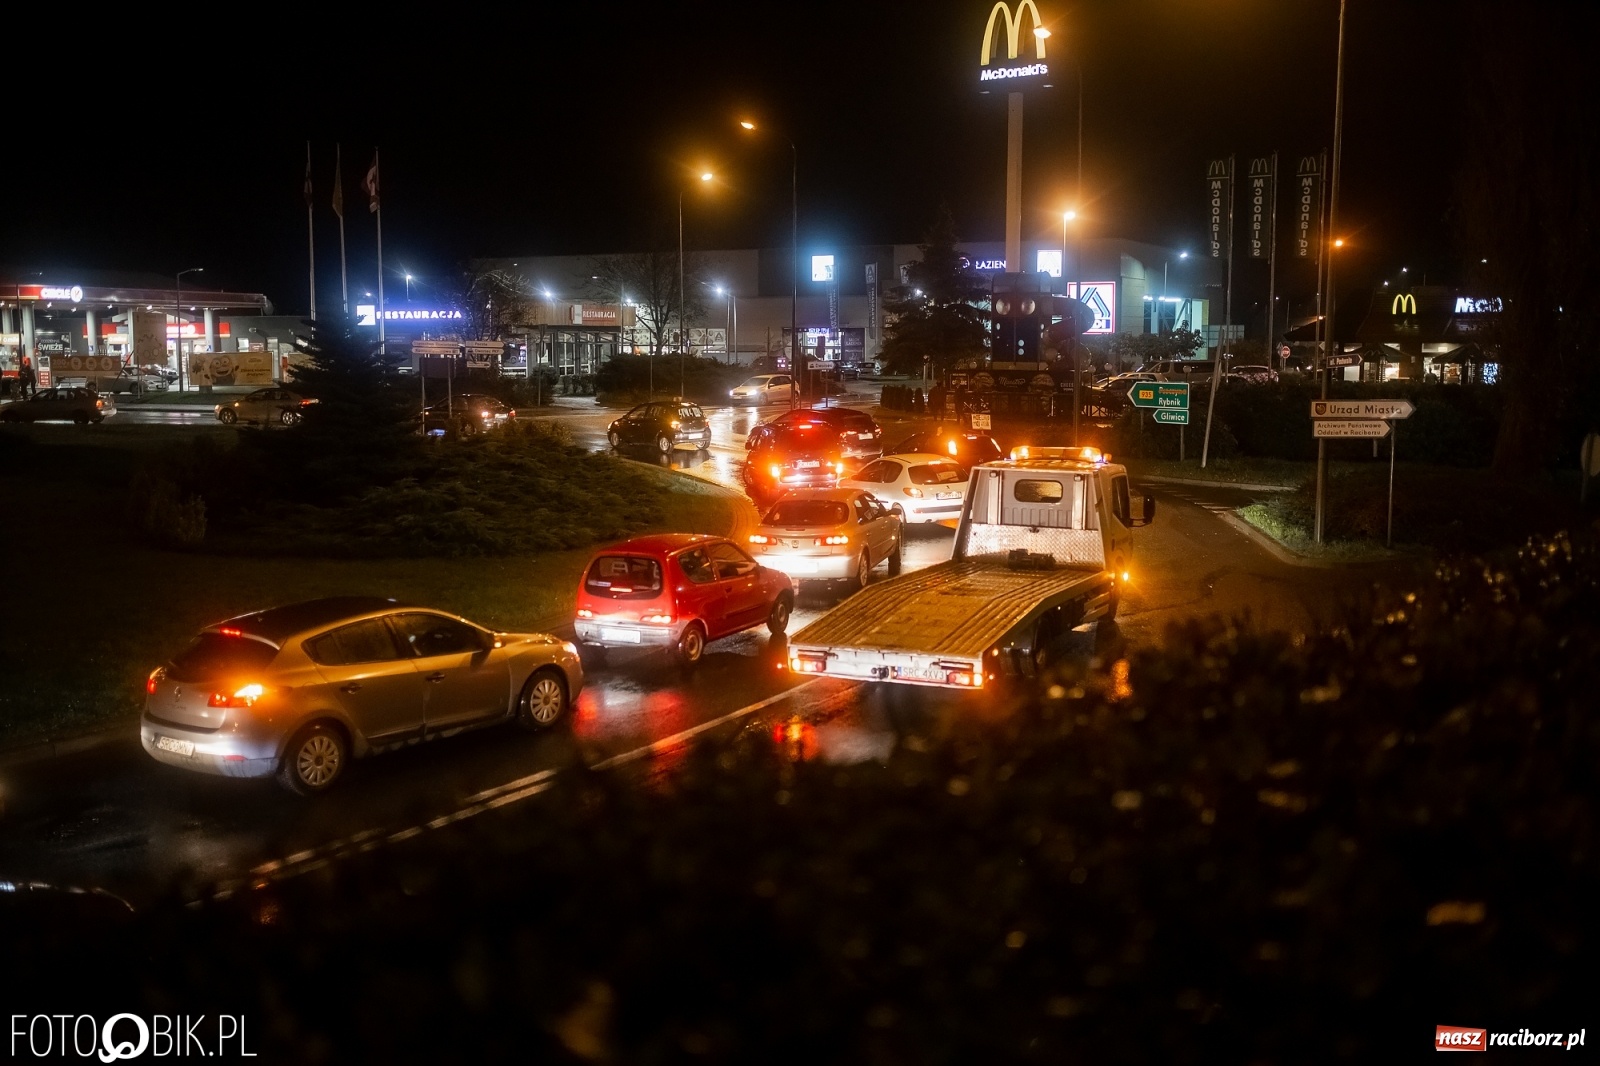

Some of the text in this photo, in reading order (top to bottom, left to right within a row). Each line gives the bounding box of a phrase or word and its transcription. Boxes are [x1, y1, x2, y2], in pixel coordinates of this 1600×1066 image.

[980, 63, 1048, 81] McDonald's
[975, 260, 1006, 269] ŁAZIEN
[376, 310, 463, 320] RESTAURACJA
[582, 310, 616, 318] RESTAURACJA
[38, 343, 63, 351] ŚWIEŻE
[1158, 397, 1181, 407] Rybnik
[1329, 404, 1402, 416] Urząd Miasta
[1160, 412, 1185, 421] Gliwice
[903, 667, 944, 680] SRC 4XV3
